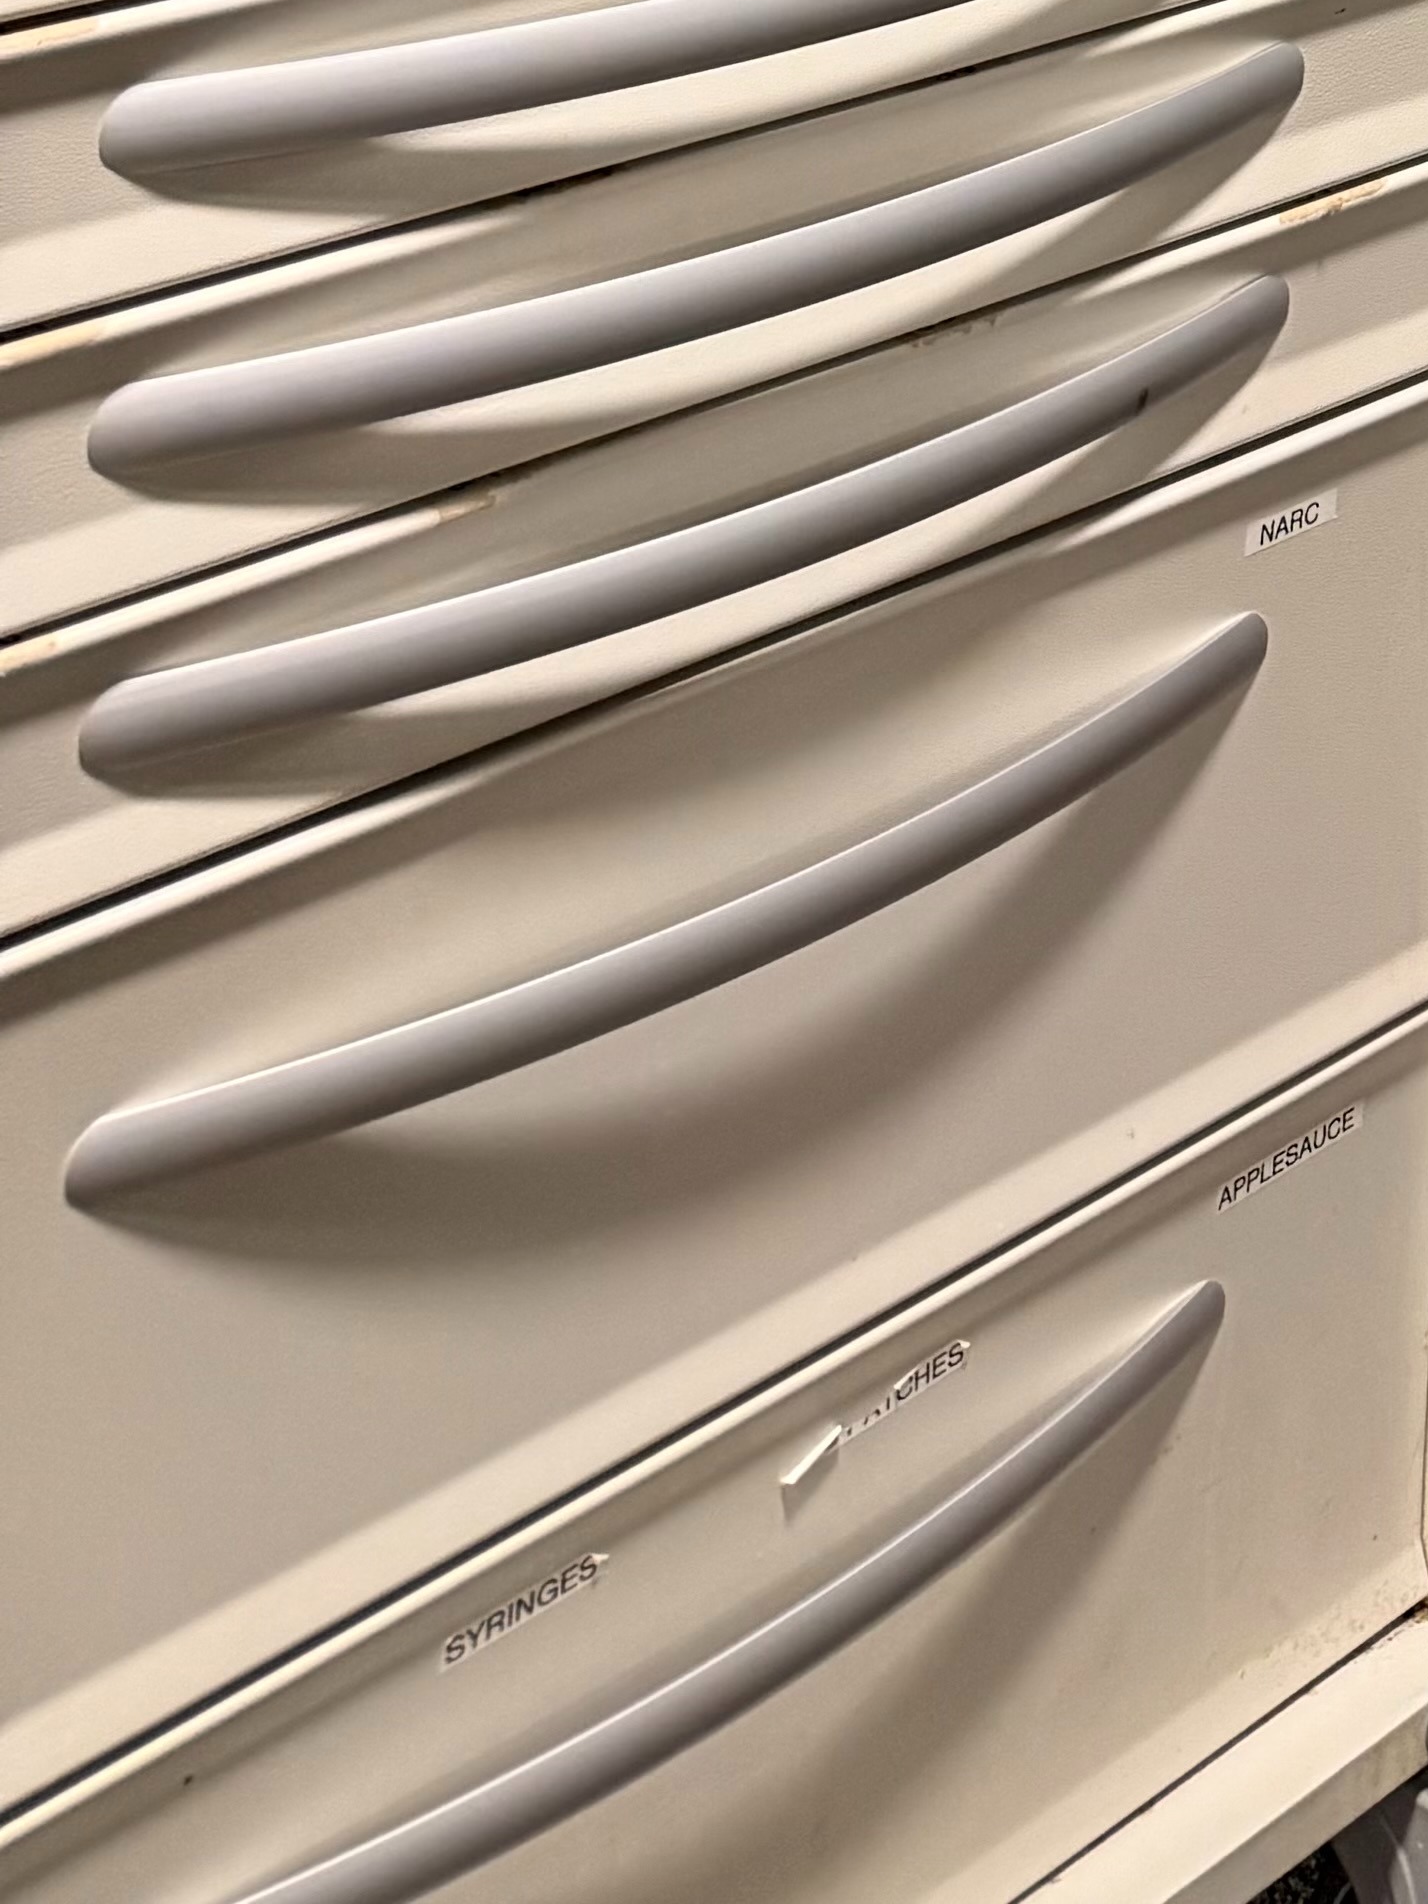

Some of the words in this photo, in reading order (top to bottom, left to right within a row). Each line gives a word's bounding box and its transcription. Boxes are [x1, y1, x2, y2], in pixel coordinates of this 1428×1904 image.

[1260, 502, 1320, 545] NARC
[1218, 1106, 1355, 1211] APPLESAUCE
[445, 1554, 598, 1665] SYRINGES
